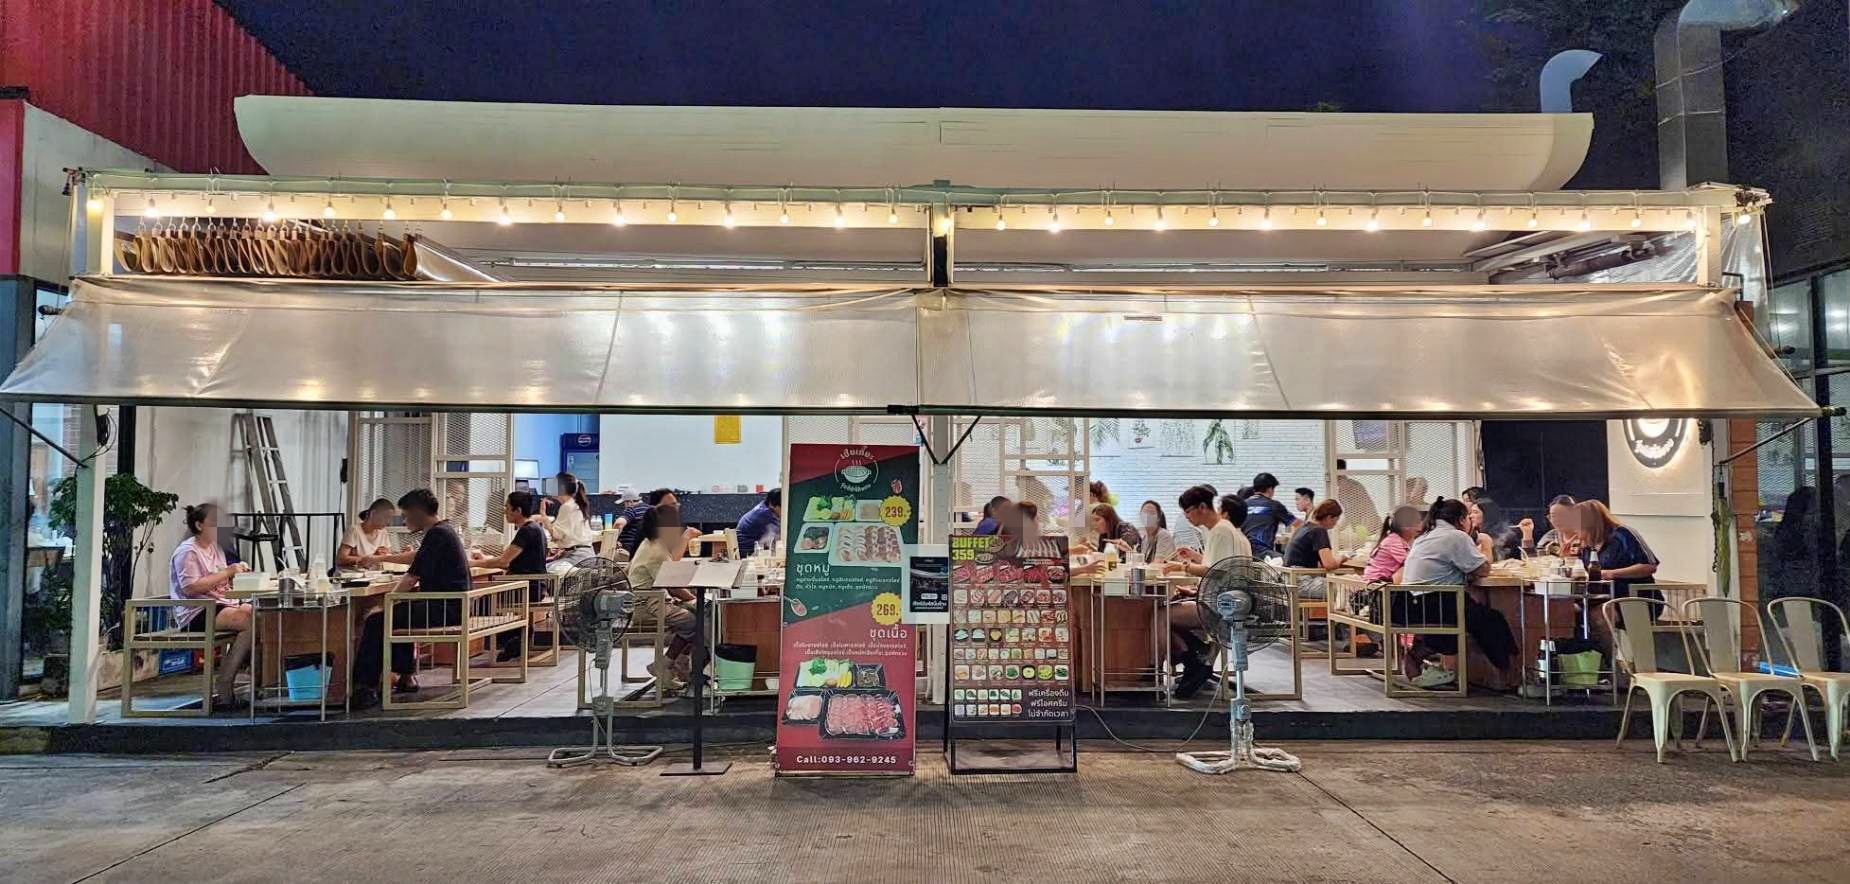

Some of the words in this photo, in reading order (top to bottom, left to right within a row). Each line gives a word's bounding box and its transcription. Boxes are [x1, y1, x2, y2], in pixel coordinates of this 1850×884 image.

[952, 537, 990, 548] BUFFET
[796, 563, 830, 577] ชุดหมู
[876, 604, 899, 616] 269.
[870, 625, 907, 641] ชุดเนื้อ
[1028, 708, 1069, 718] ไม่จำกัดเวลา
[796, 755, 896, 764] Call:093-962-9245
